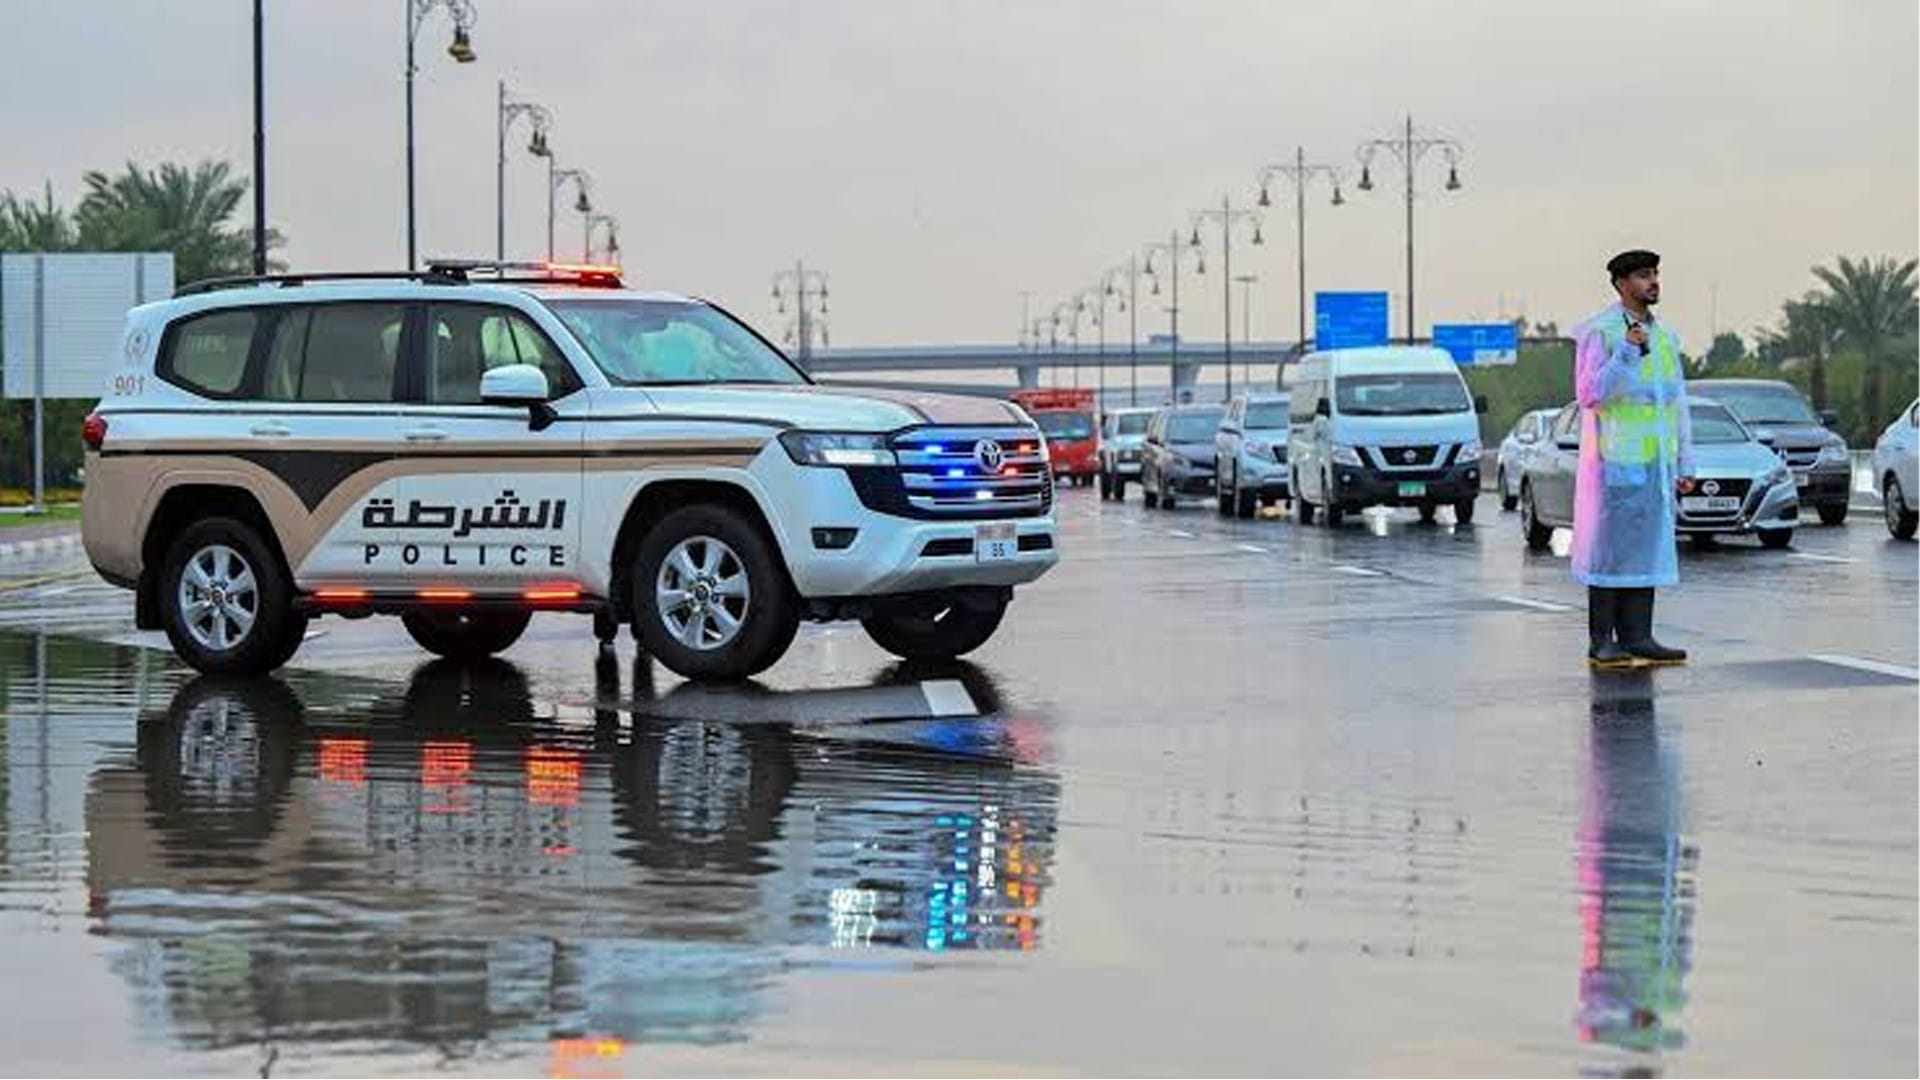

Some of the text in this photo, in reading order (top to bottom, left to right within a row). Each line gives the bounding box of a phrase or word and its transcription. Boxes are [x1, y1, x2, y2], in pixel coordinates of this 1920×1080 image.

[115, 375, 145, 396] 901
[362, 490, 567, 538] الشرطة
[364, 543, 566, 567] POLICE
